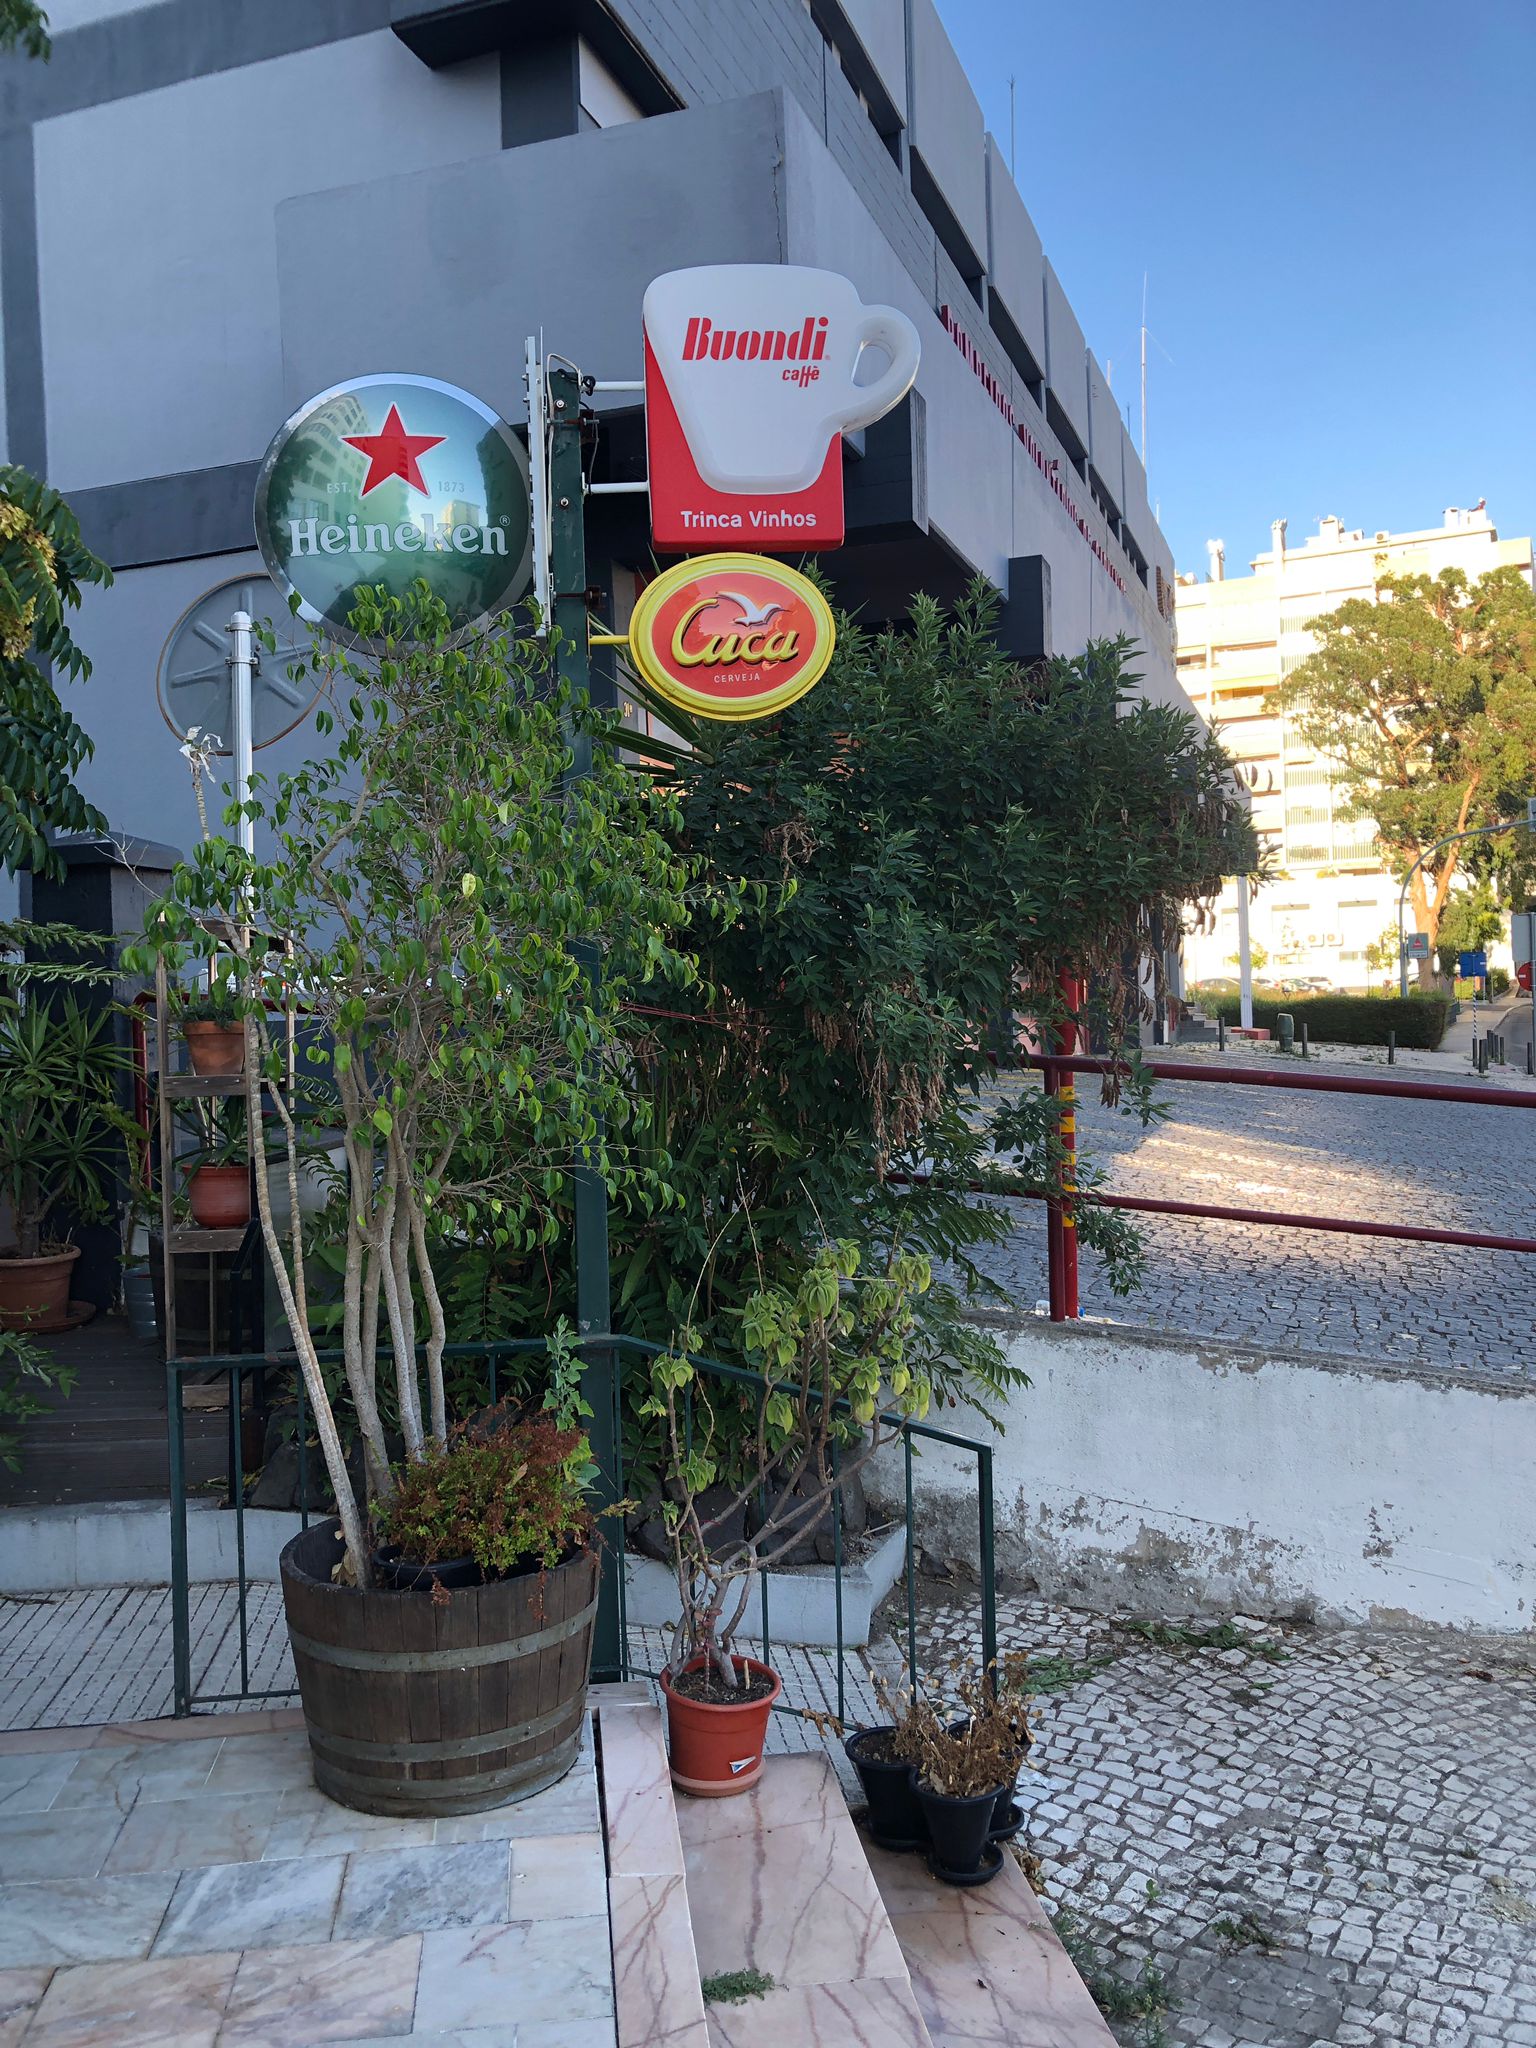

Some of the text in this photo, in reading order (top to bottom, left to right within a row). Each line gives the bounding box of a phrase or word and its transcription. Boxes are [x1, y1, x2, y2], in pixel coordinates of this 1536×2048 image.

[682, 316, 829, 361] Buondi
[782, 365, 820, 388] caffè
[327, 481, 465, 494] EST. 1873
[681, 509, 817, 528] Trinca Vinhos
[671, 598, 800, 667] Cuca
[713, 673, 760, 684] CERVEJA
